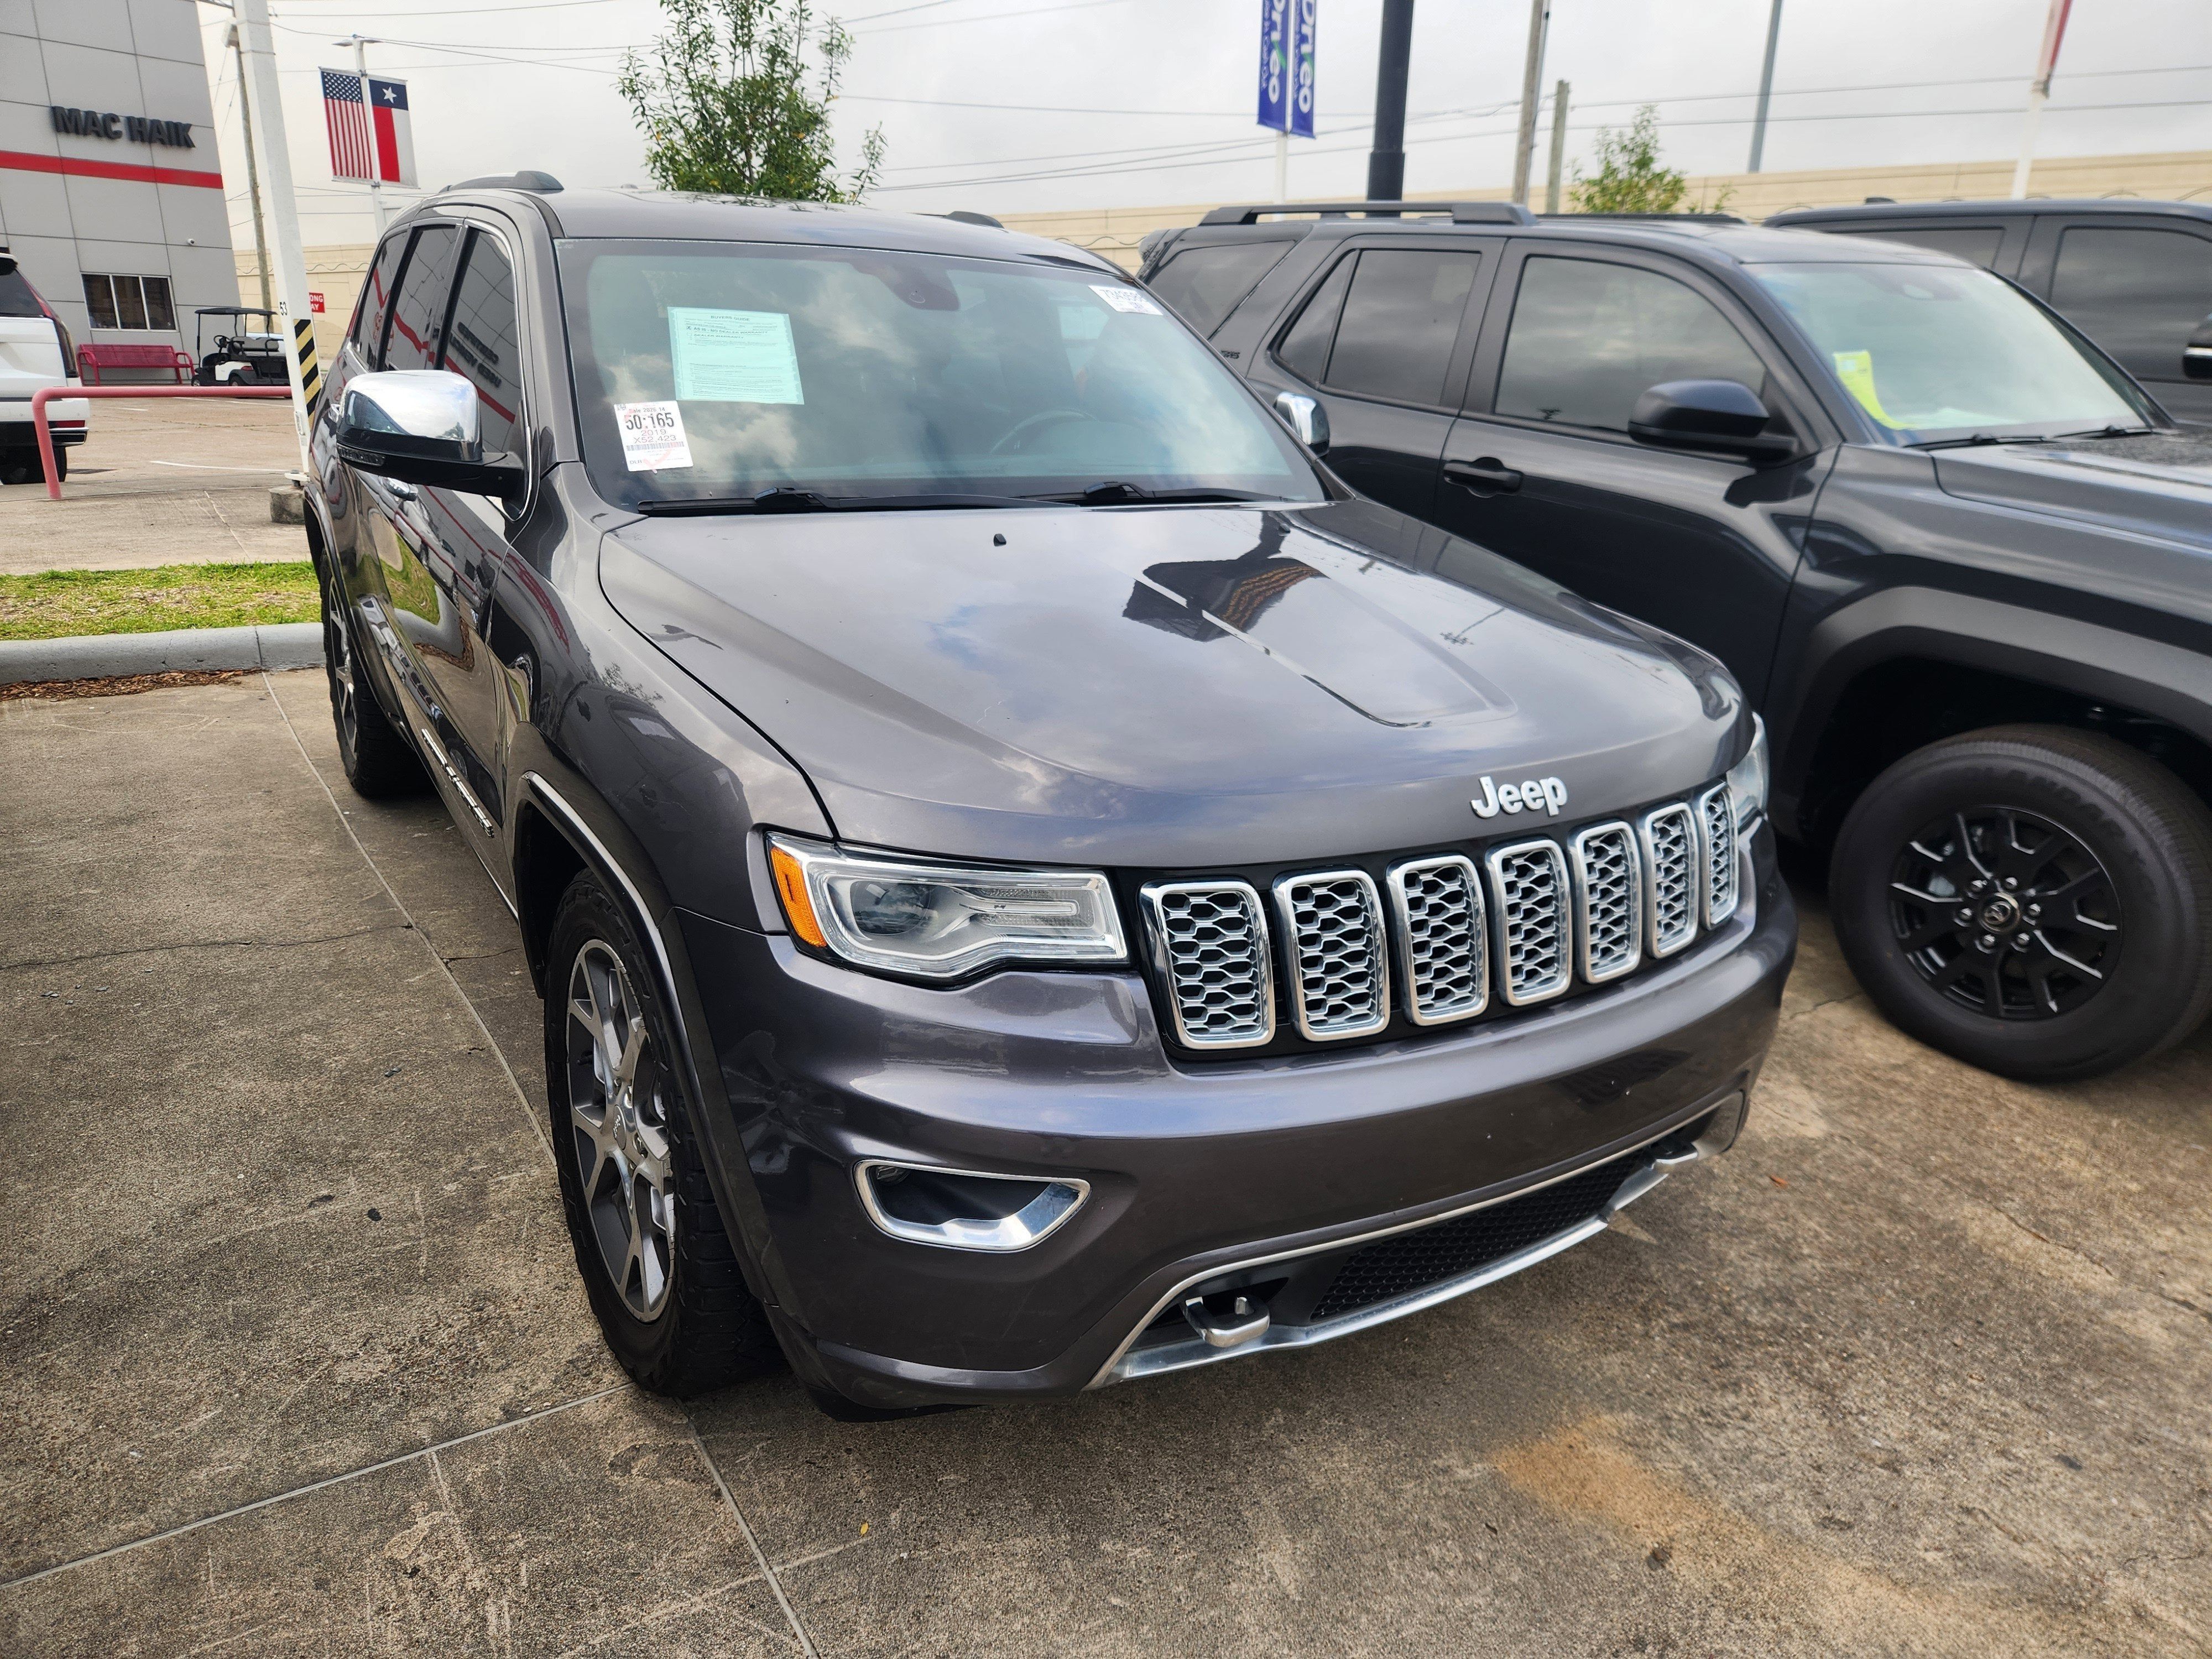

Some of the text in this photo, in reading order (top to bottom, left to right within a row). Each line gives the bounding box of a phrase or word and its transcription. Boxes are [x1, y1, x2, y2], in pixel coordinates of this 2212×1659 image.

[51, 106, 195, 148] MAC HAIK
[279, 301, 287, 315] 53
[1470, 776, 1568, 818] Jeep
